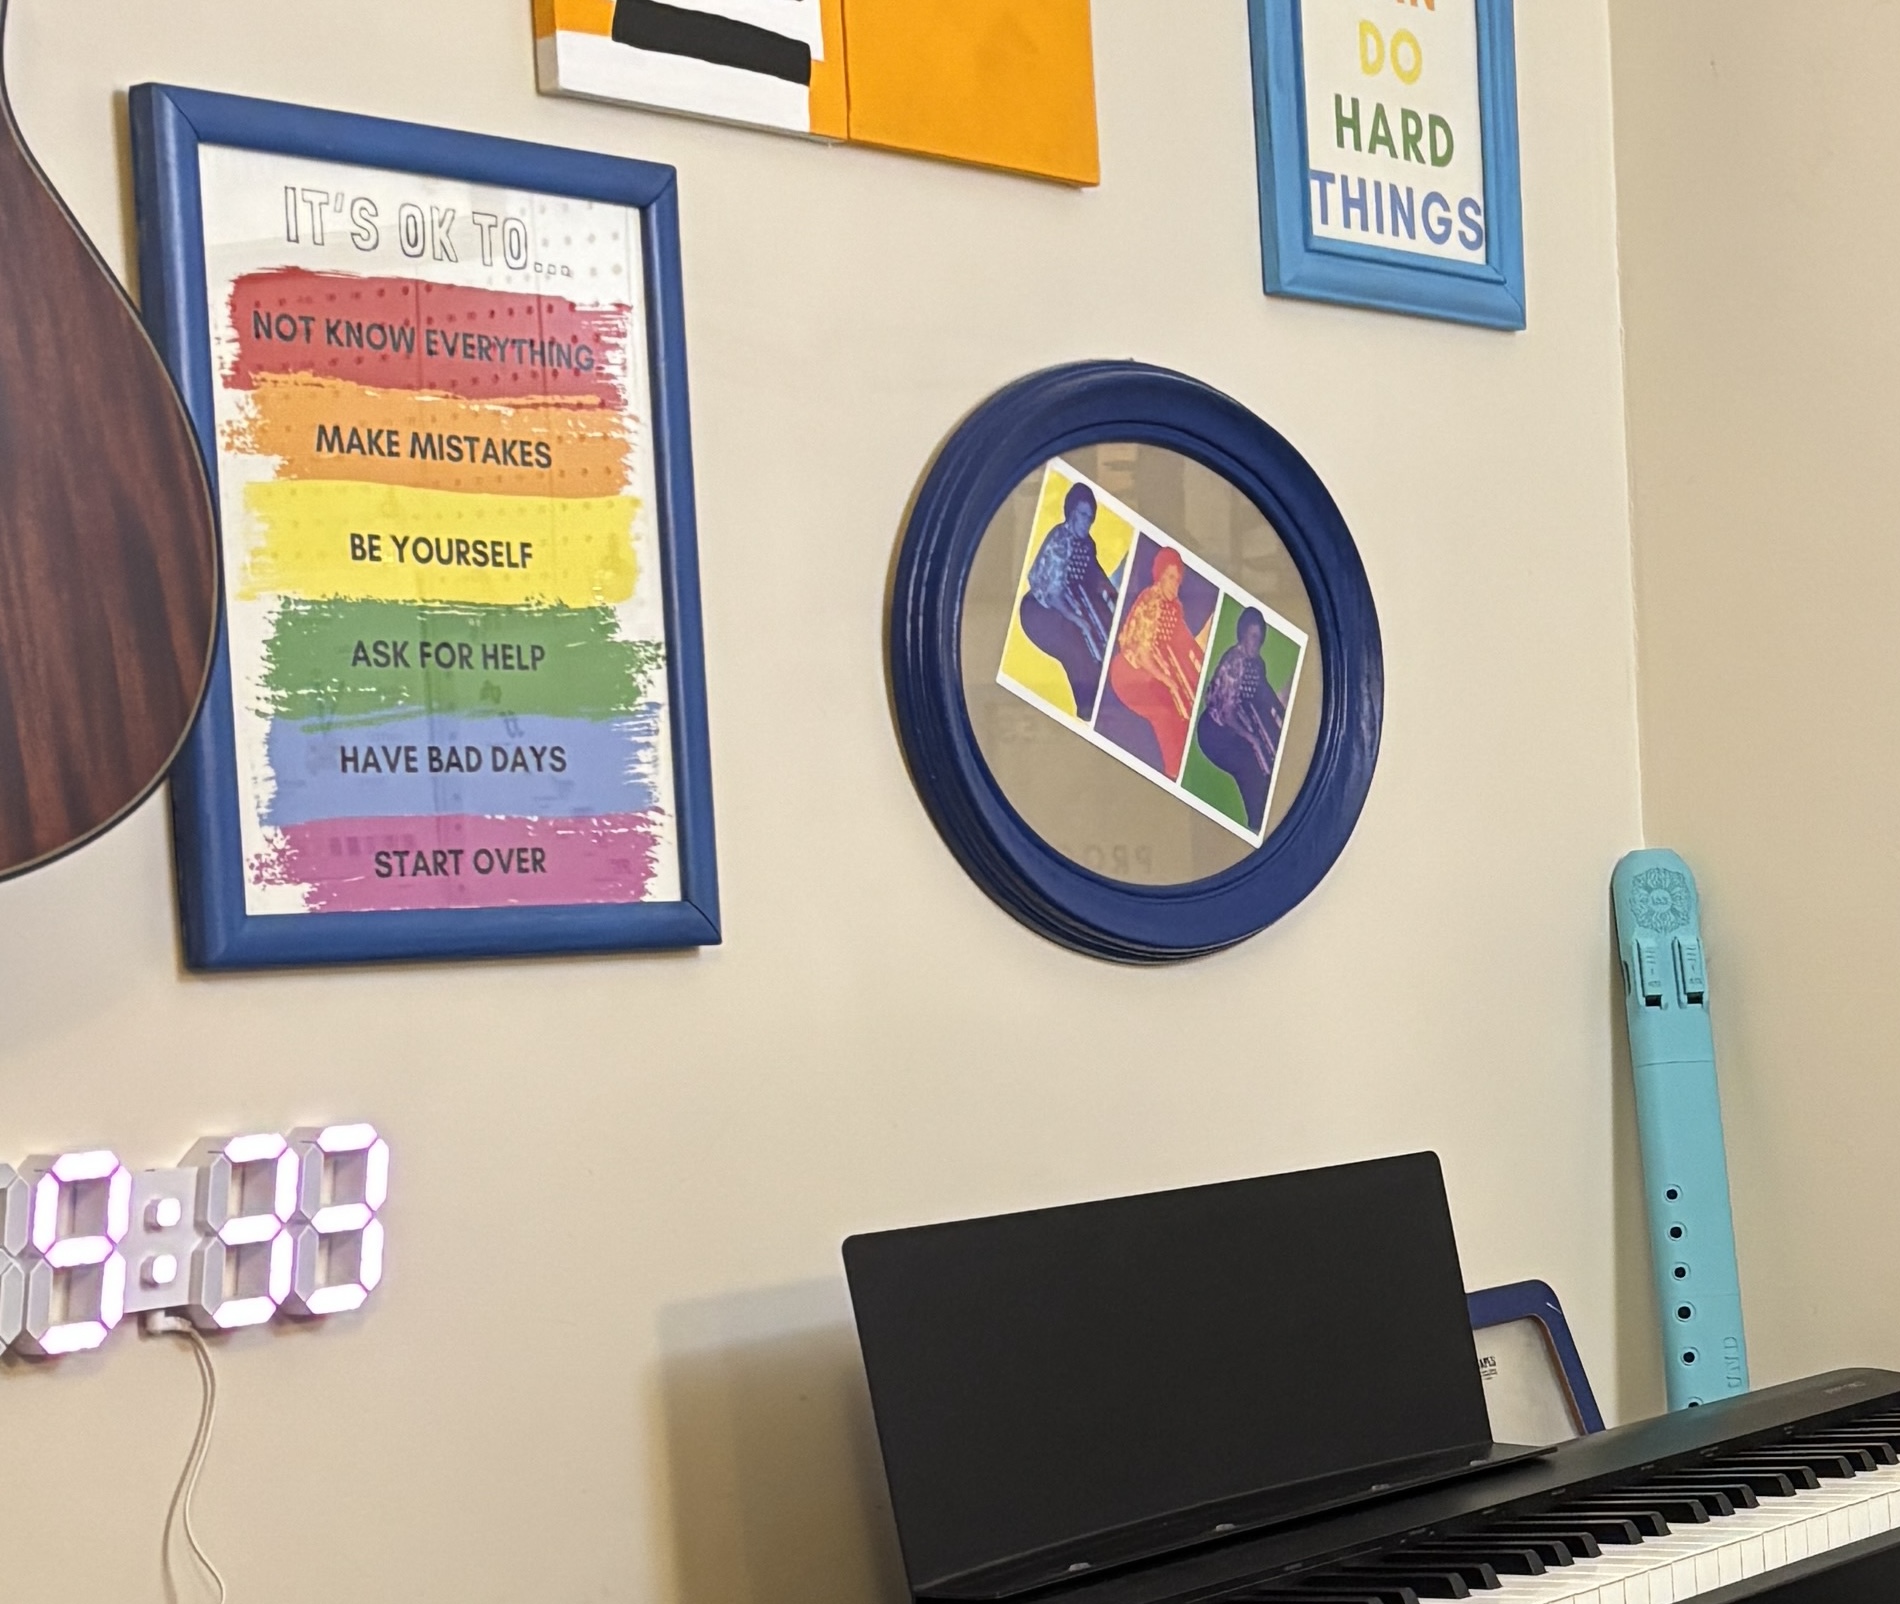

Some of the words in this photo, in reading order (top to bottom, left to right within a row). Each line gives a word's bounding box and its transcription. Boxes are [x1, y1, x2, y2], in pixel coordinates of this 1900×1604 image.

[1358, 18, 1424, 86] DO
[1333, 92, 1455, 169] HARD
[282, 184, 382, 253] IT'S
[399, 203, 460, 265] OK
[470, 211, 573, 278] TO...
[1309, 167, 1485, 252] THINGS
[251, 310, 316, 348] NOT
[324, 318, 416, 358] KNOW
[424, 329, 597, 373] EVERYTHING
[314, 423, 403, 460] MAKE
[409, 430, 554, 471] MISTAKES
[349, 532, 383, 565] BE
[390, 534, 534, 571] YOURSELF
[350, 640, 412, 671] ASK
[419, 640, 476, 672] FOR
[480, 643, 547, 673] HELP
[340, 744, 420, 775] HAVE
[427, 745, 484, 775] BAD
[490, 744, 568, 775] DAYS
[373, 847, 464, 879] START
[471, 847, 548, 878] OVER
[31, 1121, 391, 1355] 9:33
